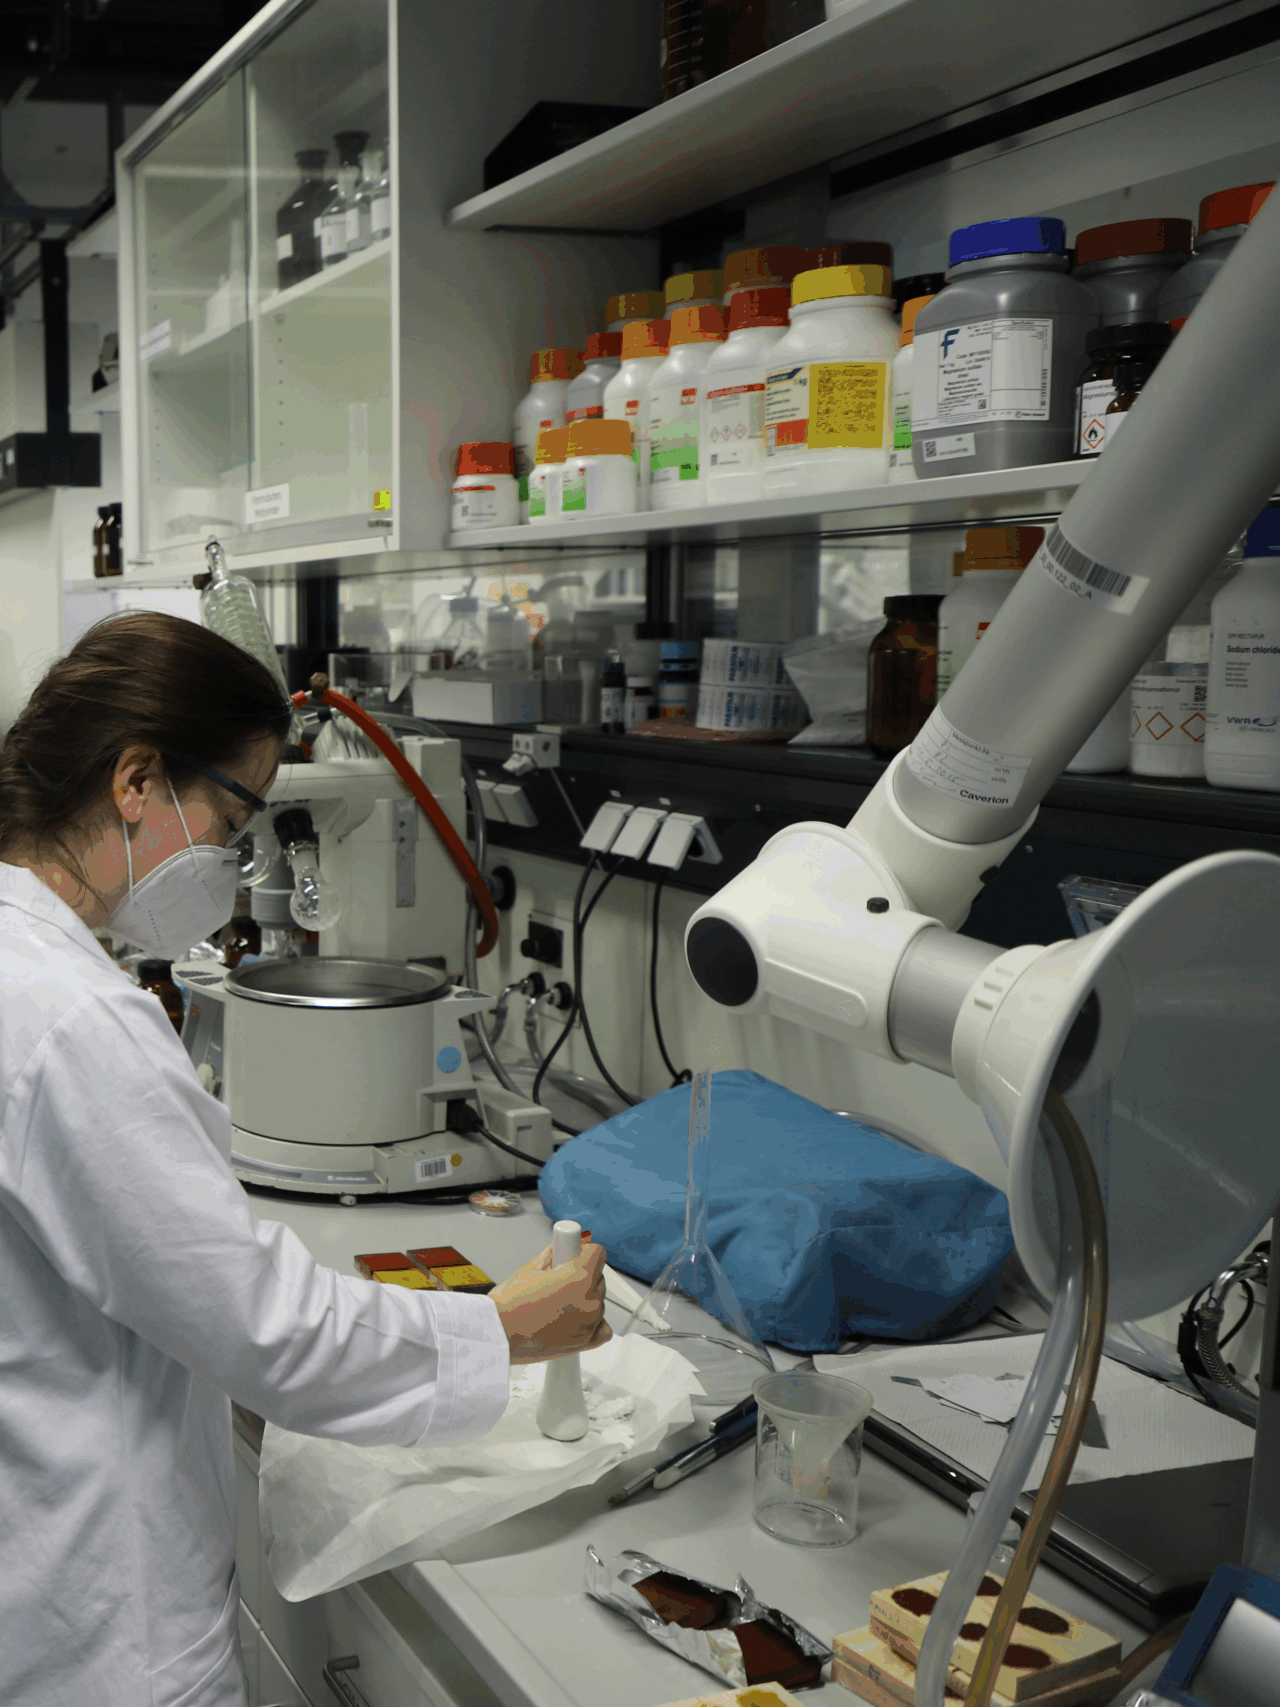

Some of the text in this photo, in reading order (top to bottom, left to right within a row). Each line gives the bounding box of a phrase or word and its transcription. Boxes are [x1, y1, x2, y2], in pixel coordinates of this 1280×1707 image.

[1227, 645, 1280, 654] Sodium chloride
[1227, 716, 1251, 725] VWR
[959, 789, 1010, 804] Caverion
